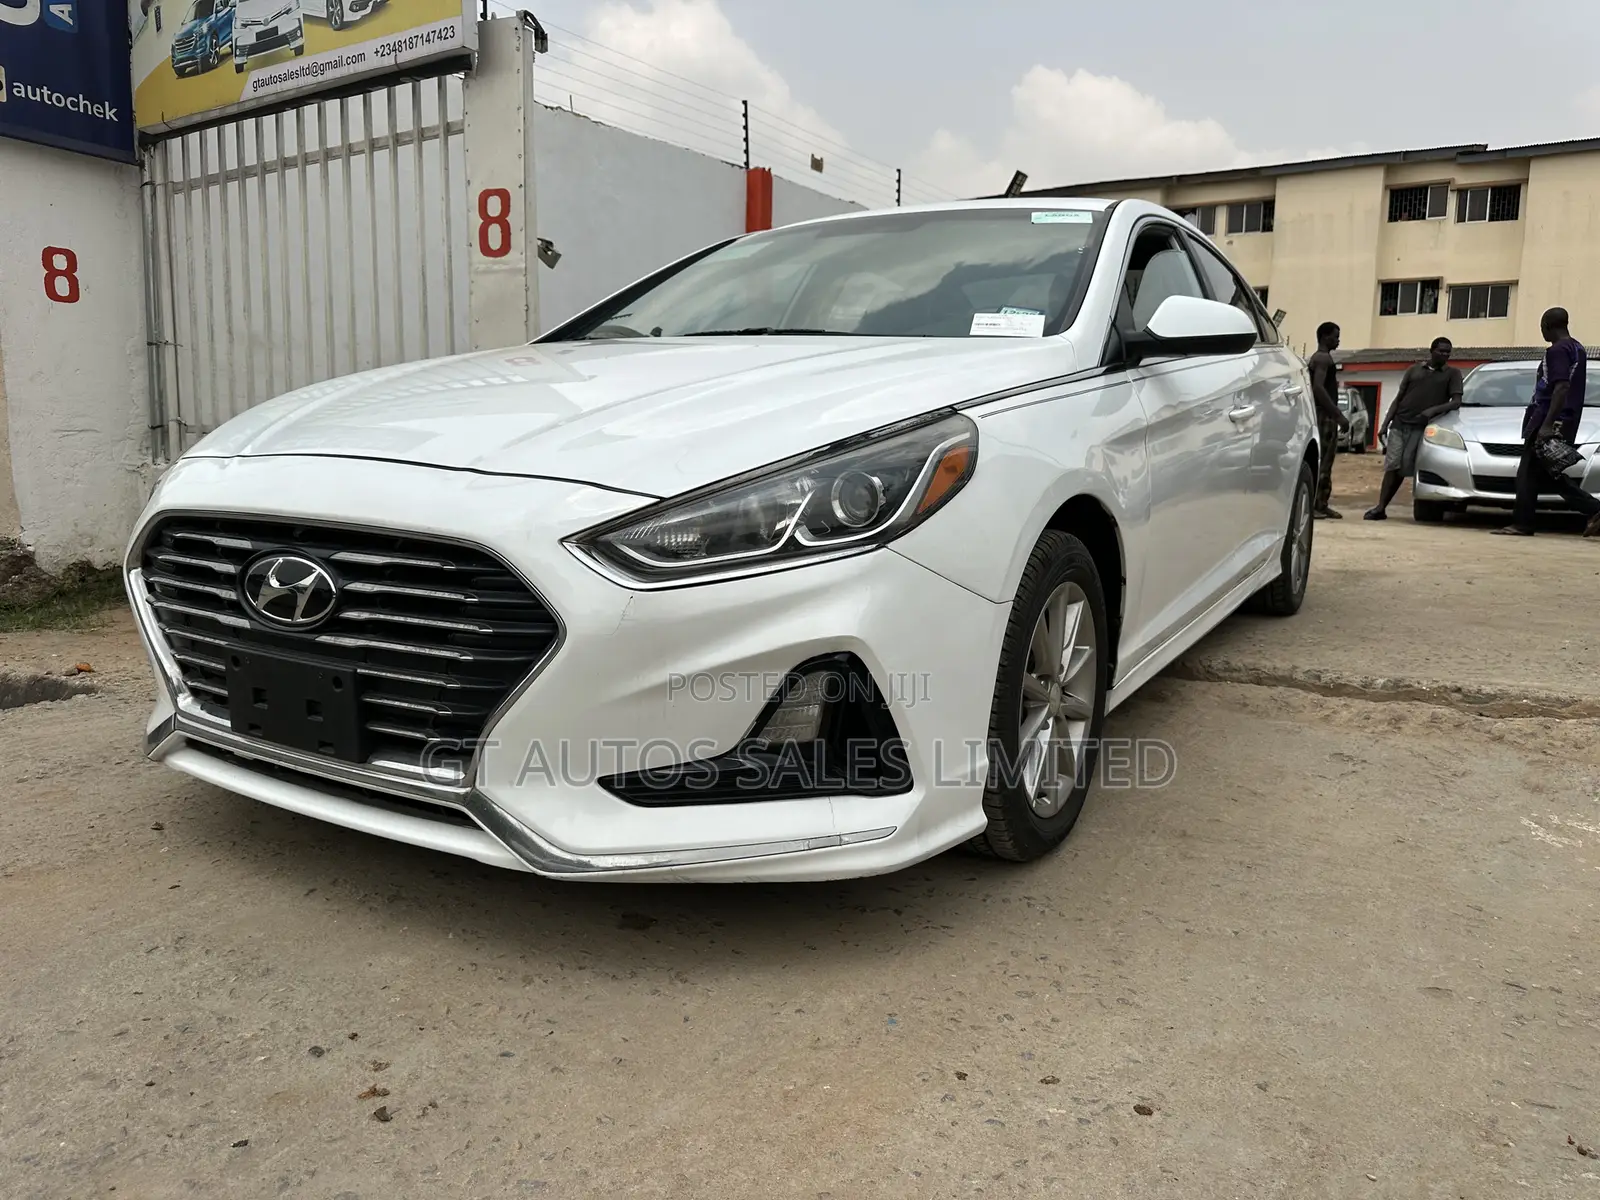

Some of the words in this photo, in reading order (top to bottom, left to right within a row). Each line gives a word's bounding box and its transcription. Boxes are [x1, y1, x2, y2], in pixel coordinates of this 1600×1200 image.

[252, 51, 366, 92] gtautosalesltd@gmail.com
[374, 25, 456, 58] +2348187147423
[12, 81, 119, 122] autochek
[478, 188, 511, 258] 8
[41, 245, 80, 304] 8
